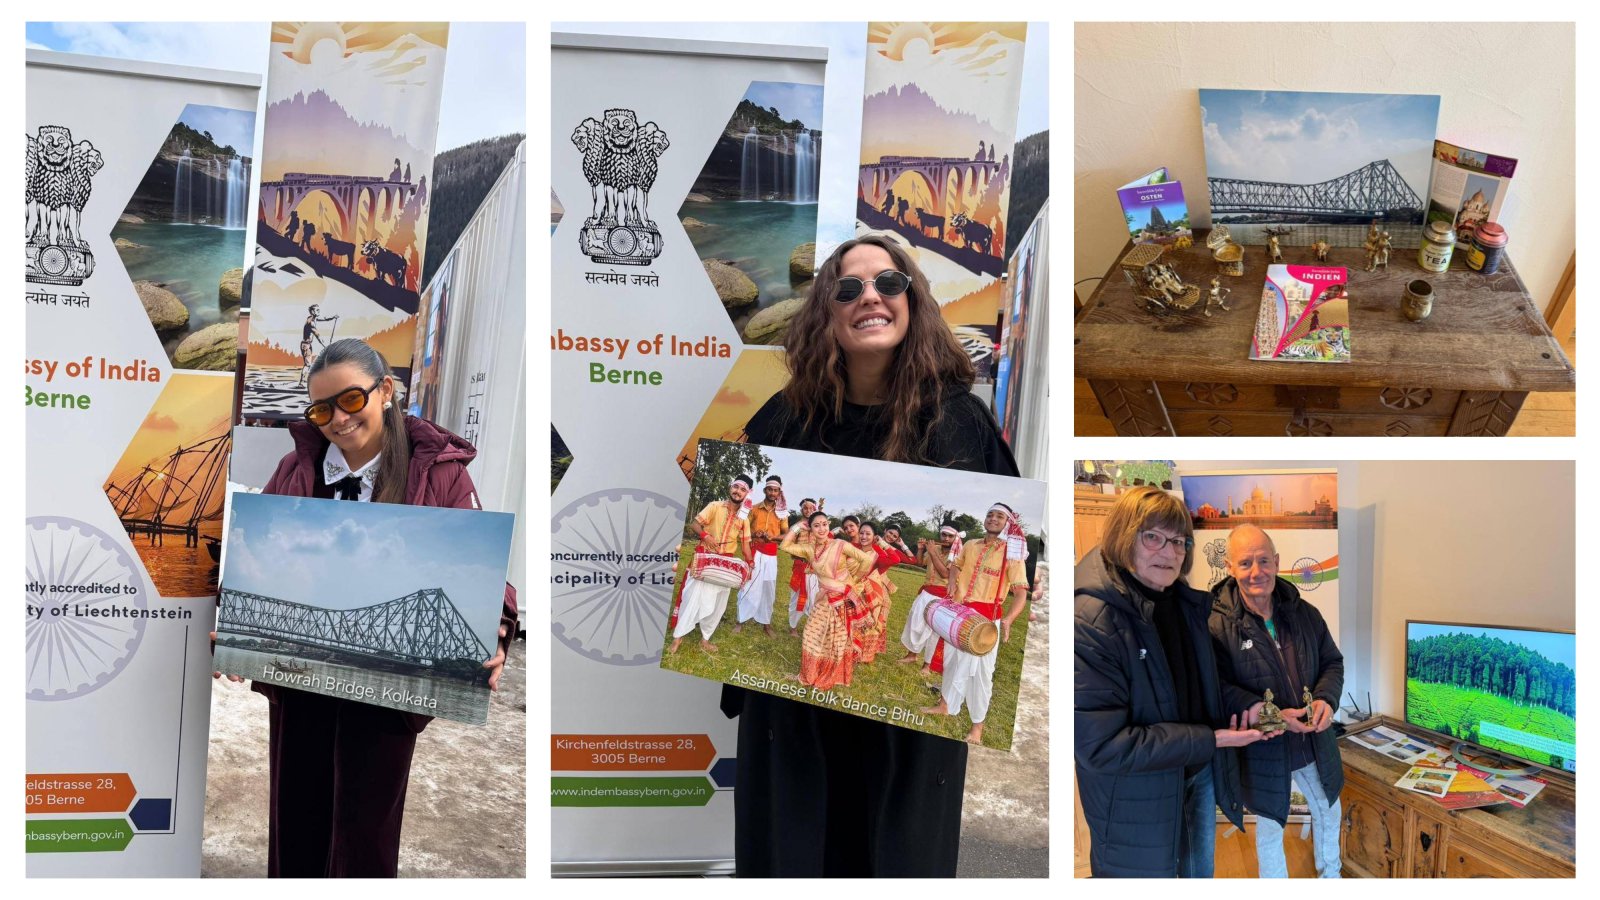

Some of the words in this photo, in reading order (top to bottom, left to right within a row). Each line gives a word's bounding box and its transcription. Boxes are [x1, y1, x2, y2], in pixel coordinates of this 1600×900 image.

[1140, 193, 1163, 201] OSTEN
[1425, 254, 1447, 265] TEA
[585, 268, 627, 286] सत्यमेव
[630, 270, 660, 287] जयते
[1302, 272, 1341, 281] INDIEN
[61, 291, 91, 308] जयते
[551, 328, 630, 360] bassy
[637, 333, 664, 355] of
[671, 335, 731, 358] India
[65, 356, 93, 378] of
[100, 358, 161, 382] India
[589, 362, 663, 386] Berne
[626, 551, 680, 563] accredit
[551, 571, 622, 588] cipality
[627, 572, 646, 585] of
[50, 582, 121, 595] accredited
[124, 584, 138, 595] to
[50, 603, 69, 617] of
[75, 604, 193, 620] Liechtenstein
[262, 665, 321, 689] Howrah
[325, 676, 377, 700] Bridge,
[382, 686, 438, 709] Kolkata
[730, 668, 808, 699] Assamese
[811, 687, 838, 707] folk
[841, 695, 888, 717] dance
[892, 705, 925, 726] Bihu
[556, 739, 673, 750] Kirchenfeldstrasse
[676, 738, 696, 751] 28,
[591, 753, 625, 764] 3005
[629, 753, 666, 764] Berne
[26, 779, 93, 791] eldstrasse
[96, 778, 117, 790] 28,
[551, 786, 706, 799] www.indembassybern.gov.in
[47, 794, 86, 805] Berne
